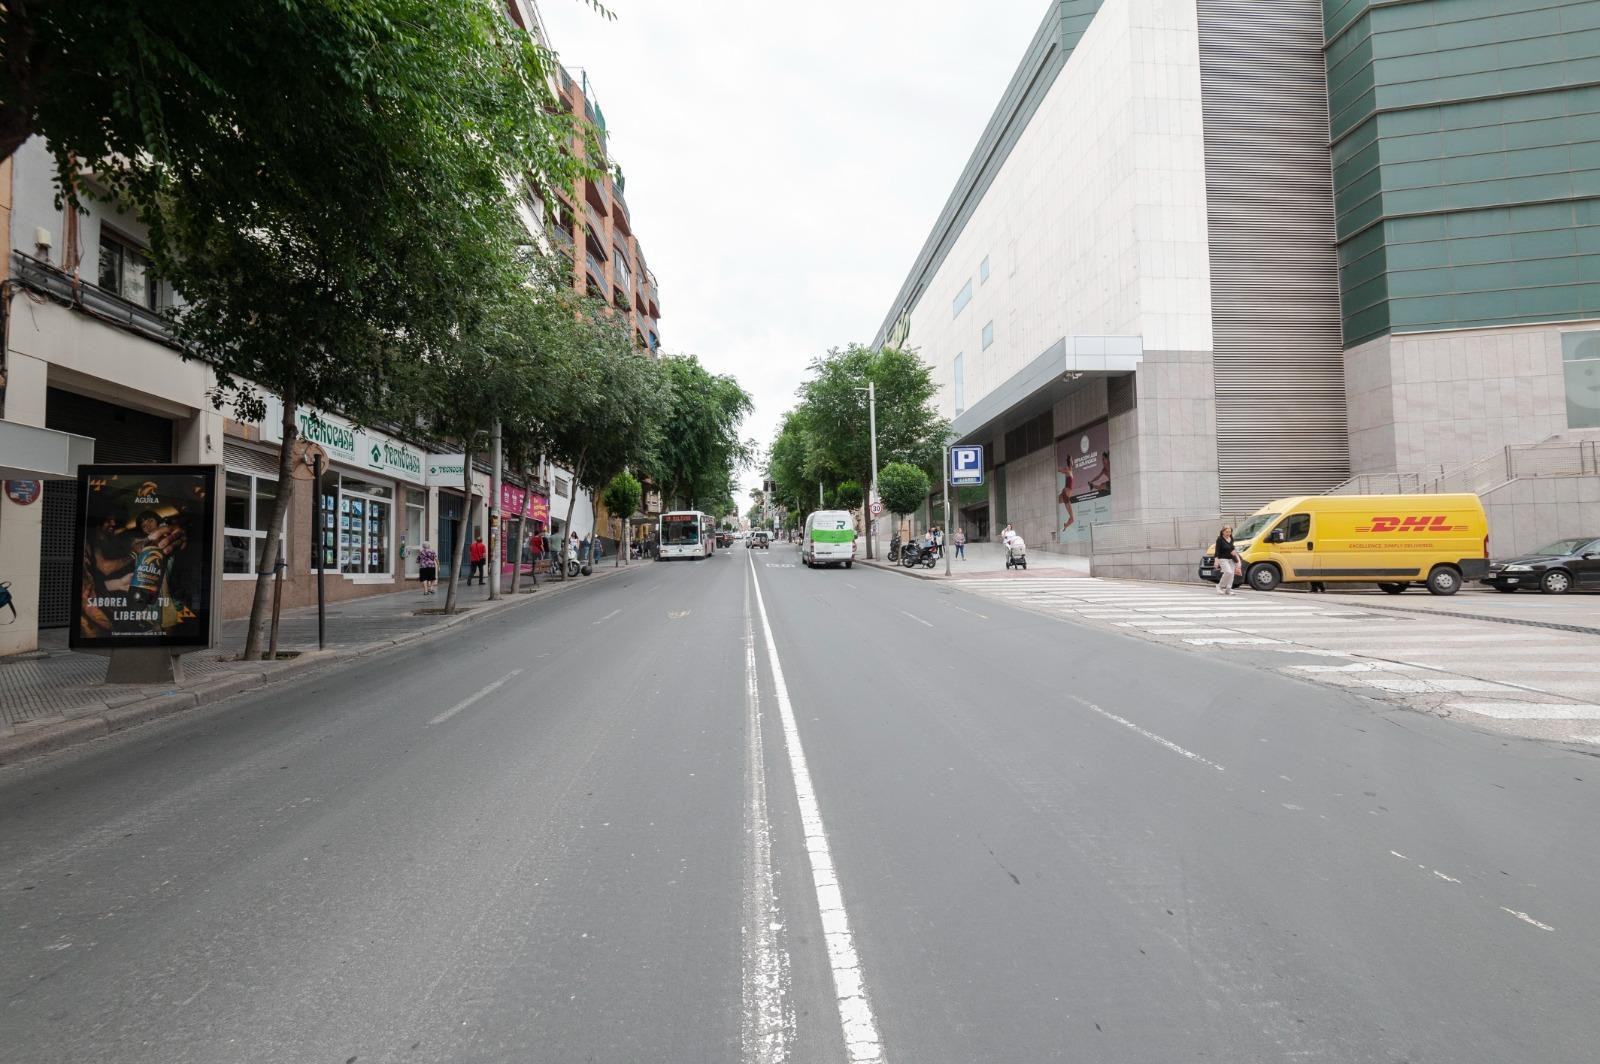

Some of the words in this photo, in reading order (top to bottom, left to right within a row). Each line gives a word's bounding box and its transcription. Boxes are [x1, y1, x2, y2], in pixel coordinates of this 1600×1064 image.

[300, 415, 354, 452] TECNOCASA
[384, 444, 420, 473] TECNOCASA
[958, 450, 975, 469] P
[439, 466, 465, 474] TECNOCA
[1371, 516, 1452, 532] DHL
[87, 597, 127, 607] SABOREA
[158, 597, 170, 607] TU
[114, 611, 158, 621] LIBERTAD
